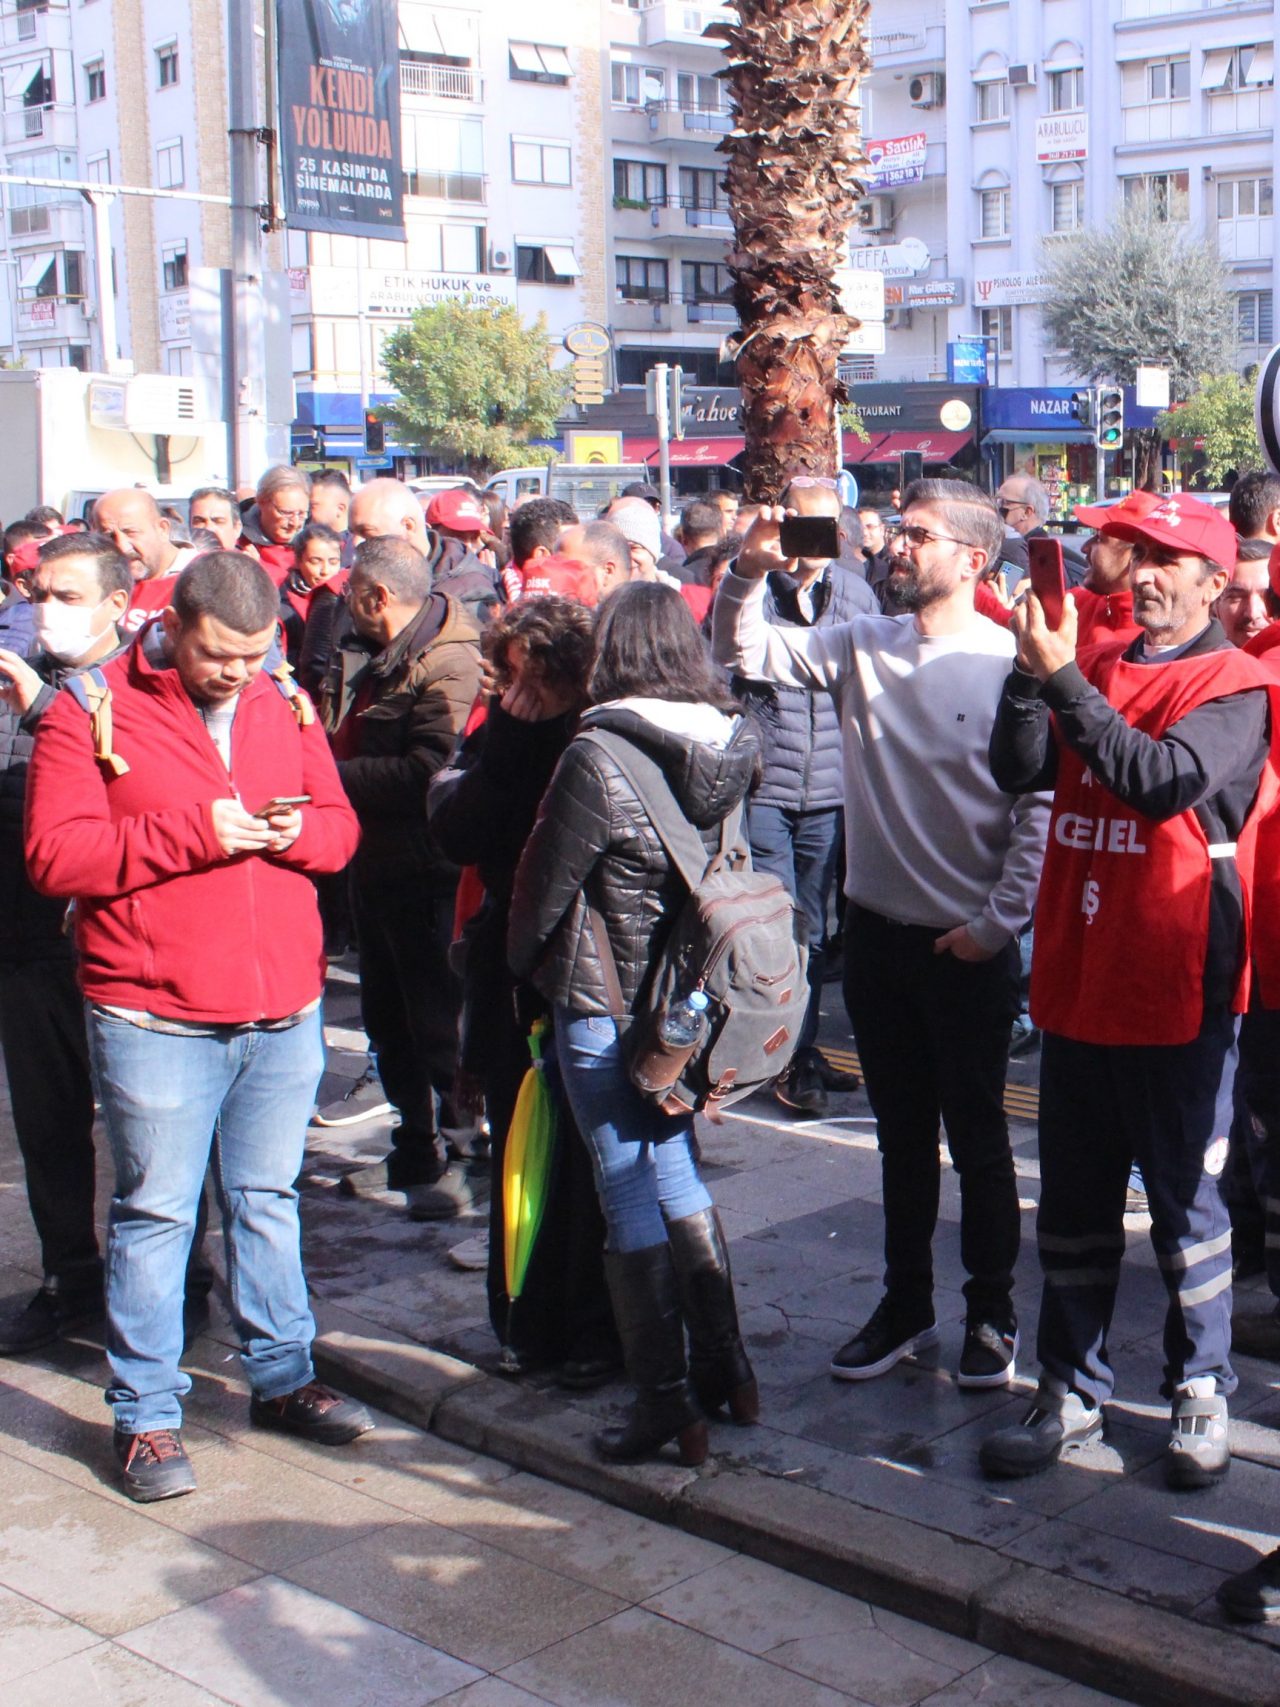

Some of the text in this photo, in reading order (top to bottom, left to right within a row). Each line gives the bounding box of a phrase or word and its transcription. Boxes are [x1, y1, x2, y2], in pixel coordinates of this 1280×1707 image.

[309, 64, 375, 116] KENDİ
[292, 105, 393, 160] YOLUMDA
[299, 157, 389, 183] 25 KASIM'DA
[296, 172, 393, 200] SİNEMALARDA
[421, 277, 471, 292] HUKUK
[475, 281, 492, 292] ve
[1031, 400, 1070, 415] NAZAR
